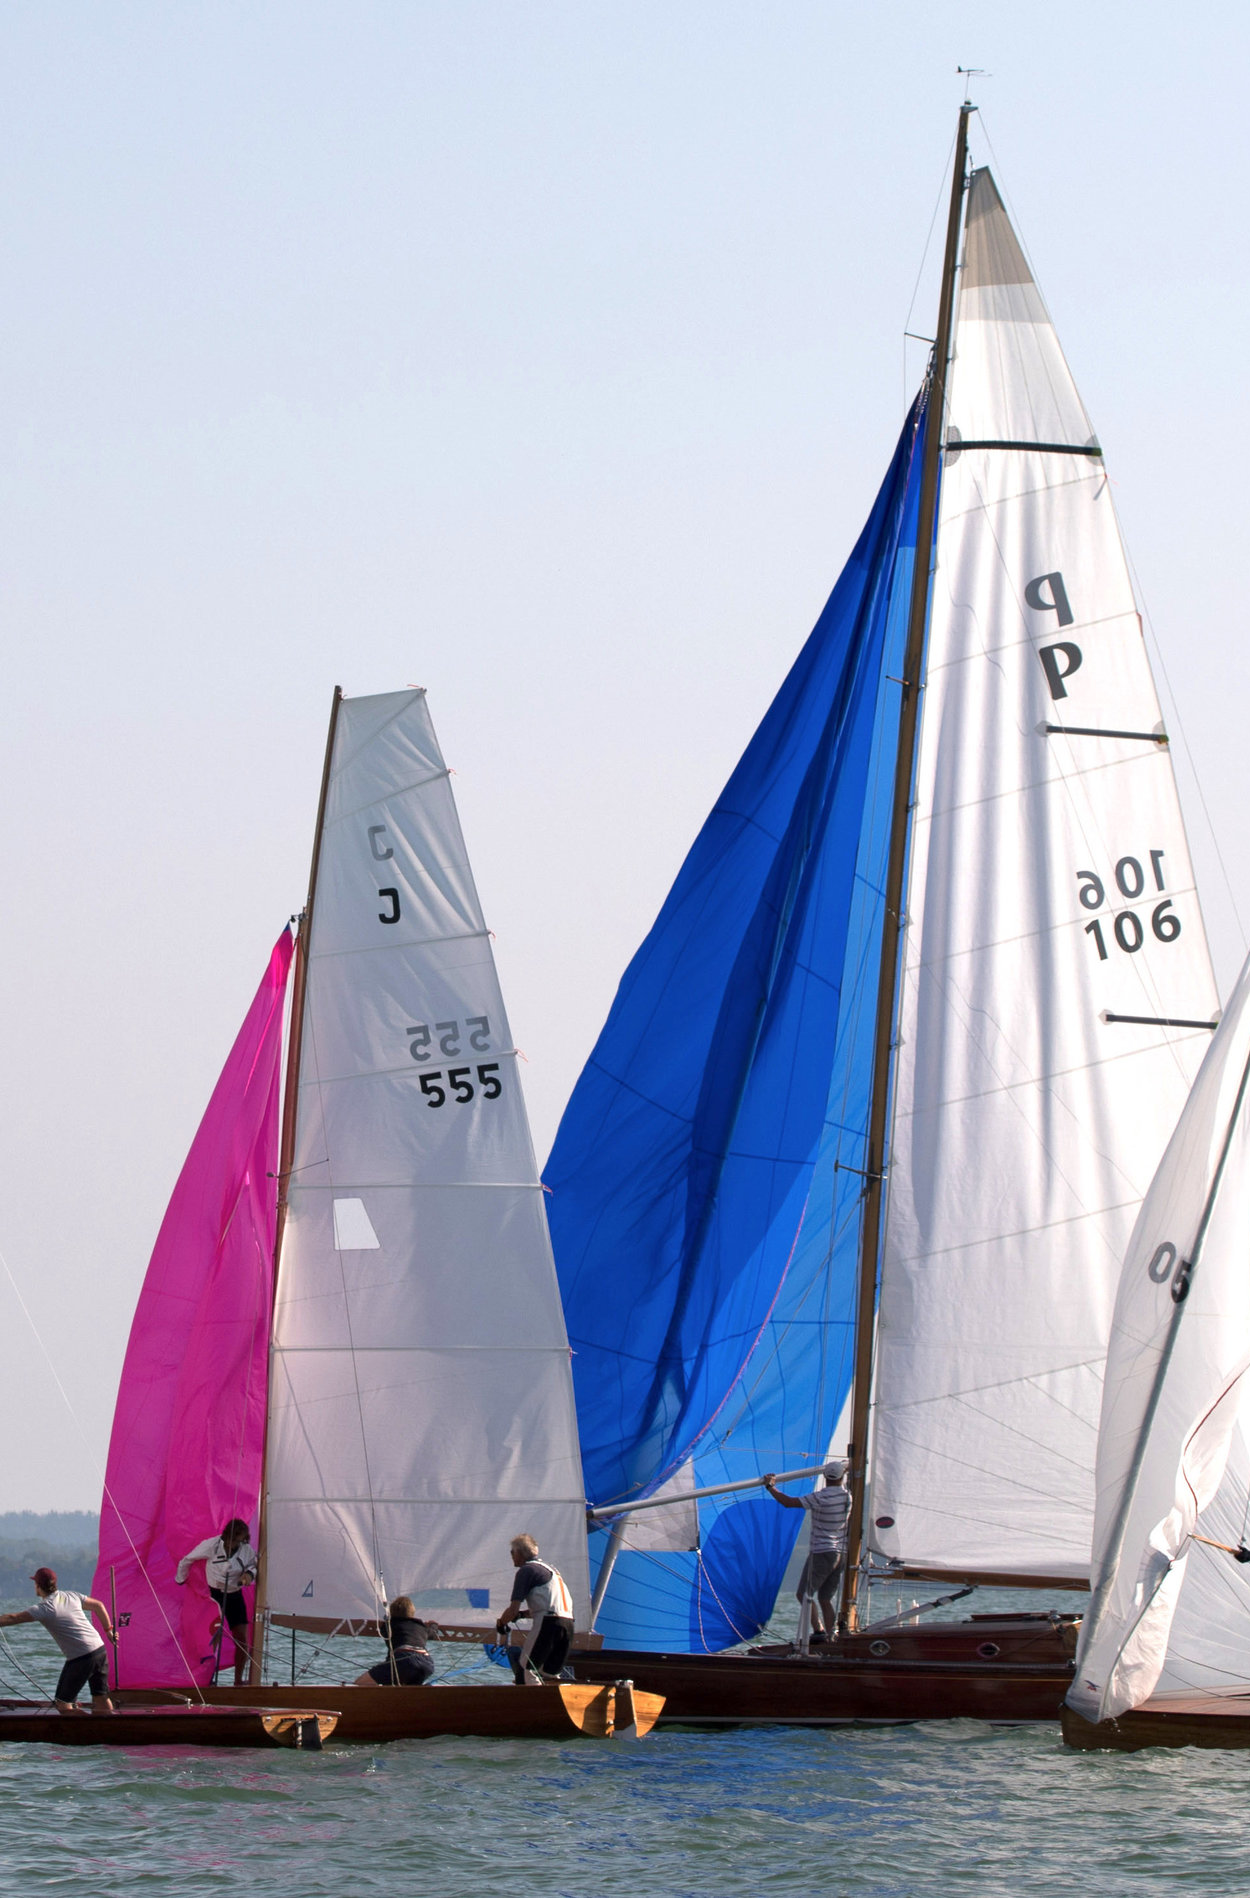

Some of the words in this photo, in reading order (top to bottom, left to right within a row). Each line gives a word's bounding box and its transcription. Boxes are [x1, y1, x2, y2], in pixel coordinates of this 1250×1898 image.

[1038, 641, 1083, 701] P
[378, 887, 401, 925] J
[1083, 899, 1182, 961] 106
[418, 1063, 503, 1108] 555
